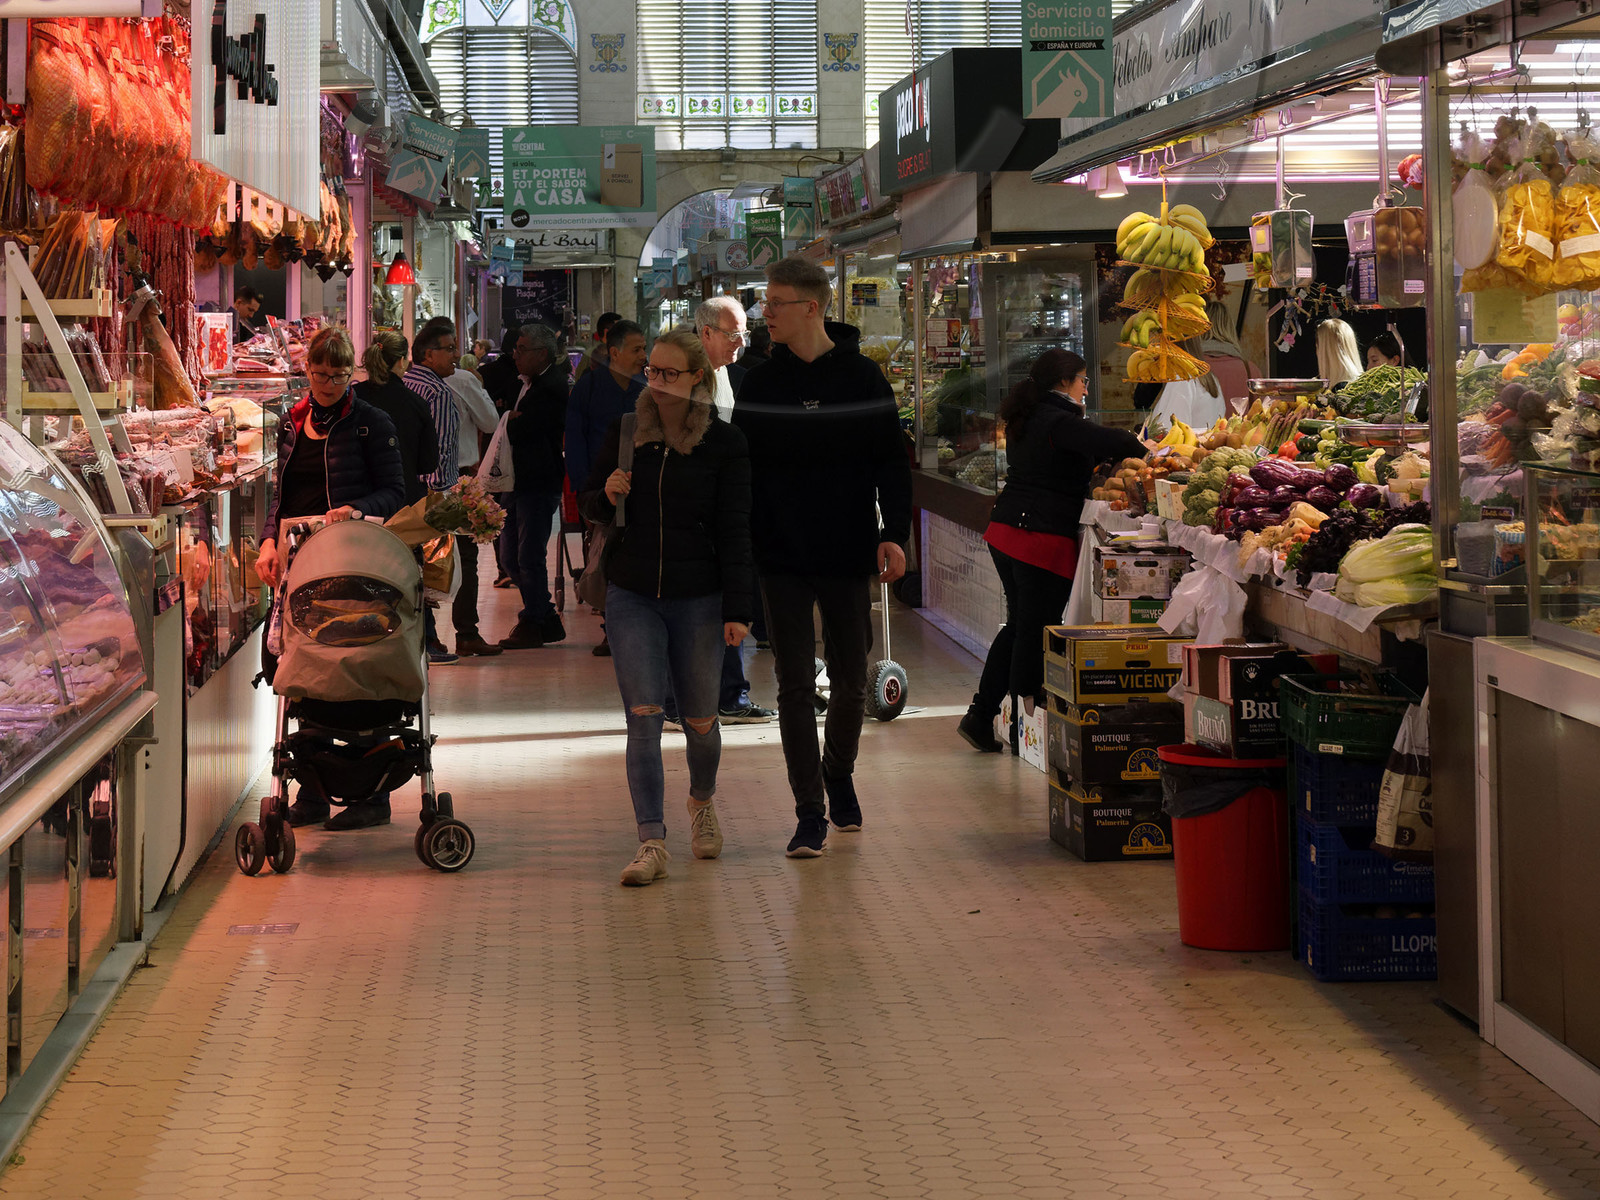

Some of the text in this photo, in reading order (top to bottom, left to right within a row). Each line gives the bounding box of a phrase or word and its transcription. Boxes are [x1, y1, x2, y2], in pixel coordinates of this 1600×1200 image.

[1026, 2, 1106, 19] Servicio a
[1030, 21, 1105, 39] domicilio
[1047, 41, 1069, 50] ESPAÑA
[1165, 6, 1231, 74] Amparo
[409, 121, 454, 147] Servicio a
[406, 135, 449, 157] domicilio
[520, 143, 545, 151] CENTRAL
[513, 168, 587, 179] ET PORTEM
[513, 179, 587, 189] TOT EL SABOR
[513, 188, 587, 206] A CASA
[533, 217, 637, 225] mercadocentralvalencia.es
[751, 217, 769, 225] Servei
[1091, 733, 1131, 744] BOUTIQUE
[1095, 744, 1128, 752] Palmerita
[1093, 808, 1133, 818] BOUTIQUE
[1402, 830, 1410, 841] 3
